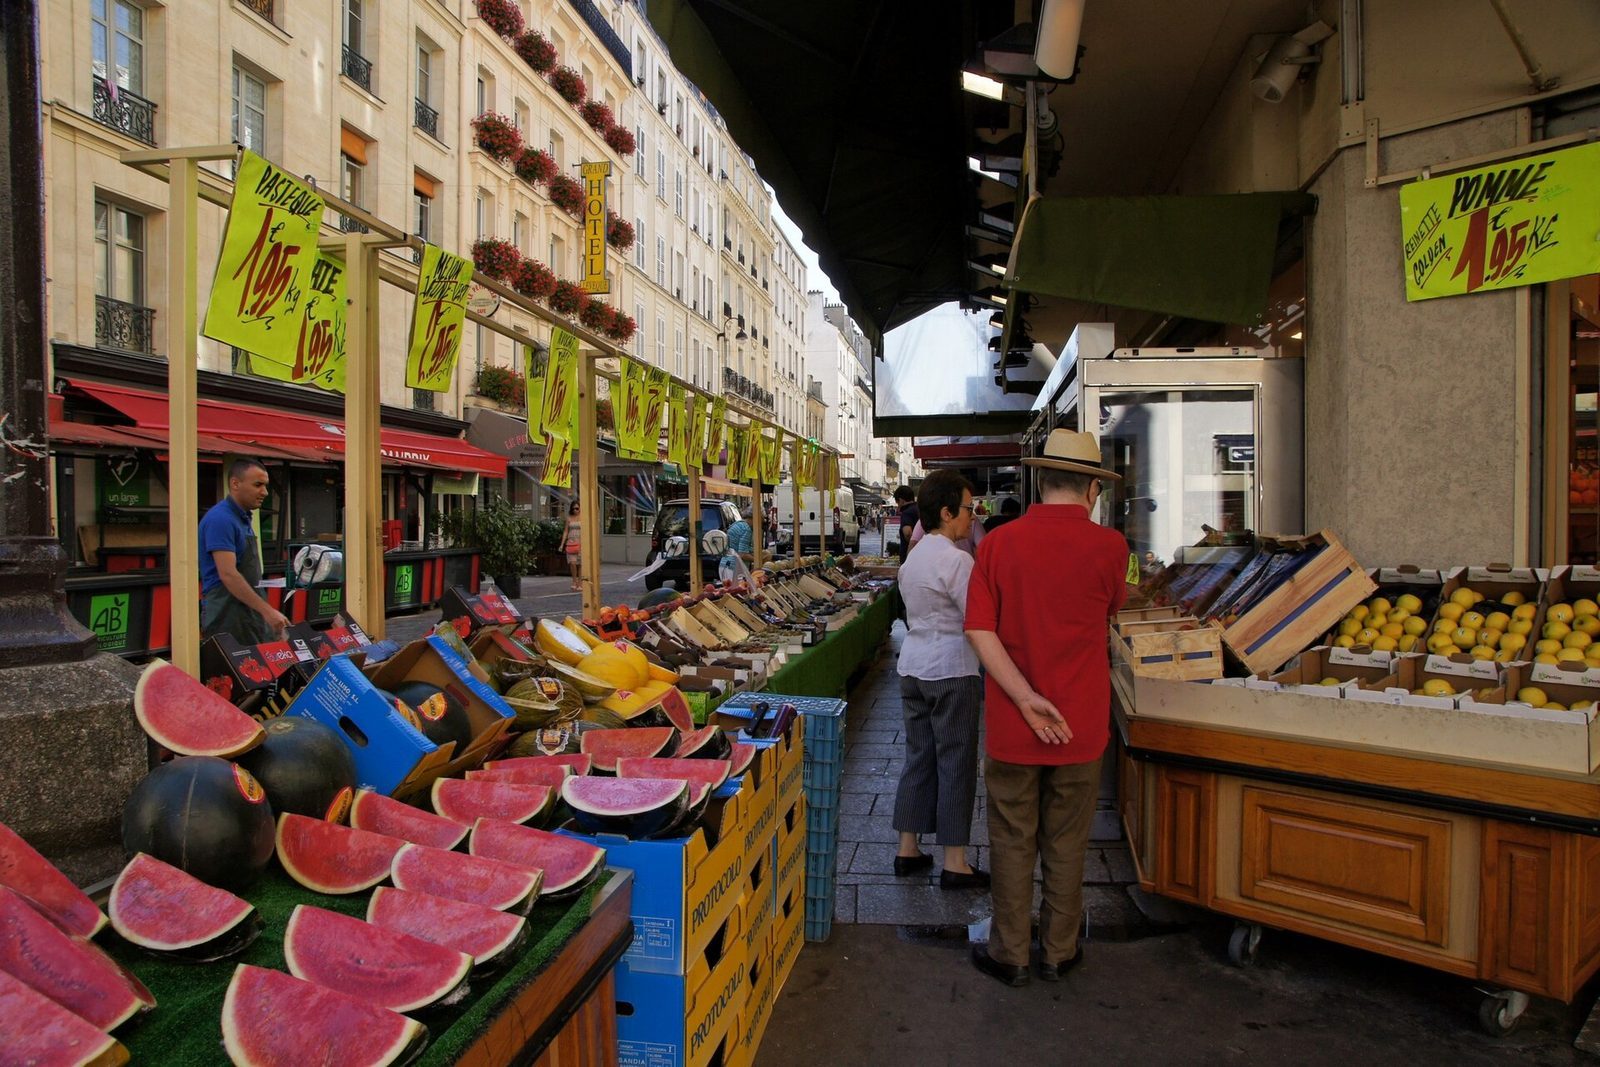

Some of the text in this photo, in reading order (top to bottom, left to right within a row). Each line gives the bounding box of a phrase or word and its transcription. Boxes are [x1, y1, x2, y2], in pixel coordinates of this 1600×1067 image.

[255, 164, 322, 217] PASTEQUE
[582, 163, 609, 174] GRAND
[1448, 160, 1556, 220] POMME
[588, 179, 602, 276] HOTEL
[1404, 202, 1442, 260] REINETTE
[92, 607, 122, 632] AB
[692, 855, 743, 935] PROTOCOLO
[690, 962, 744, 1059] PROTOCOLO
